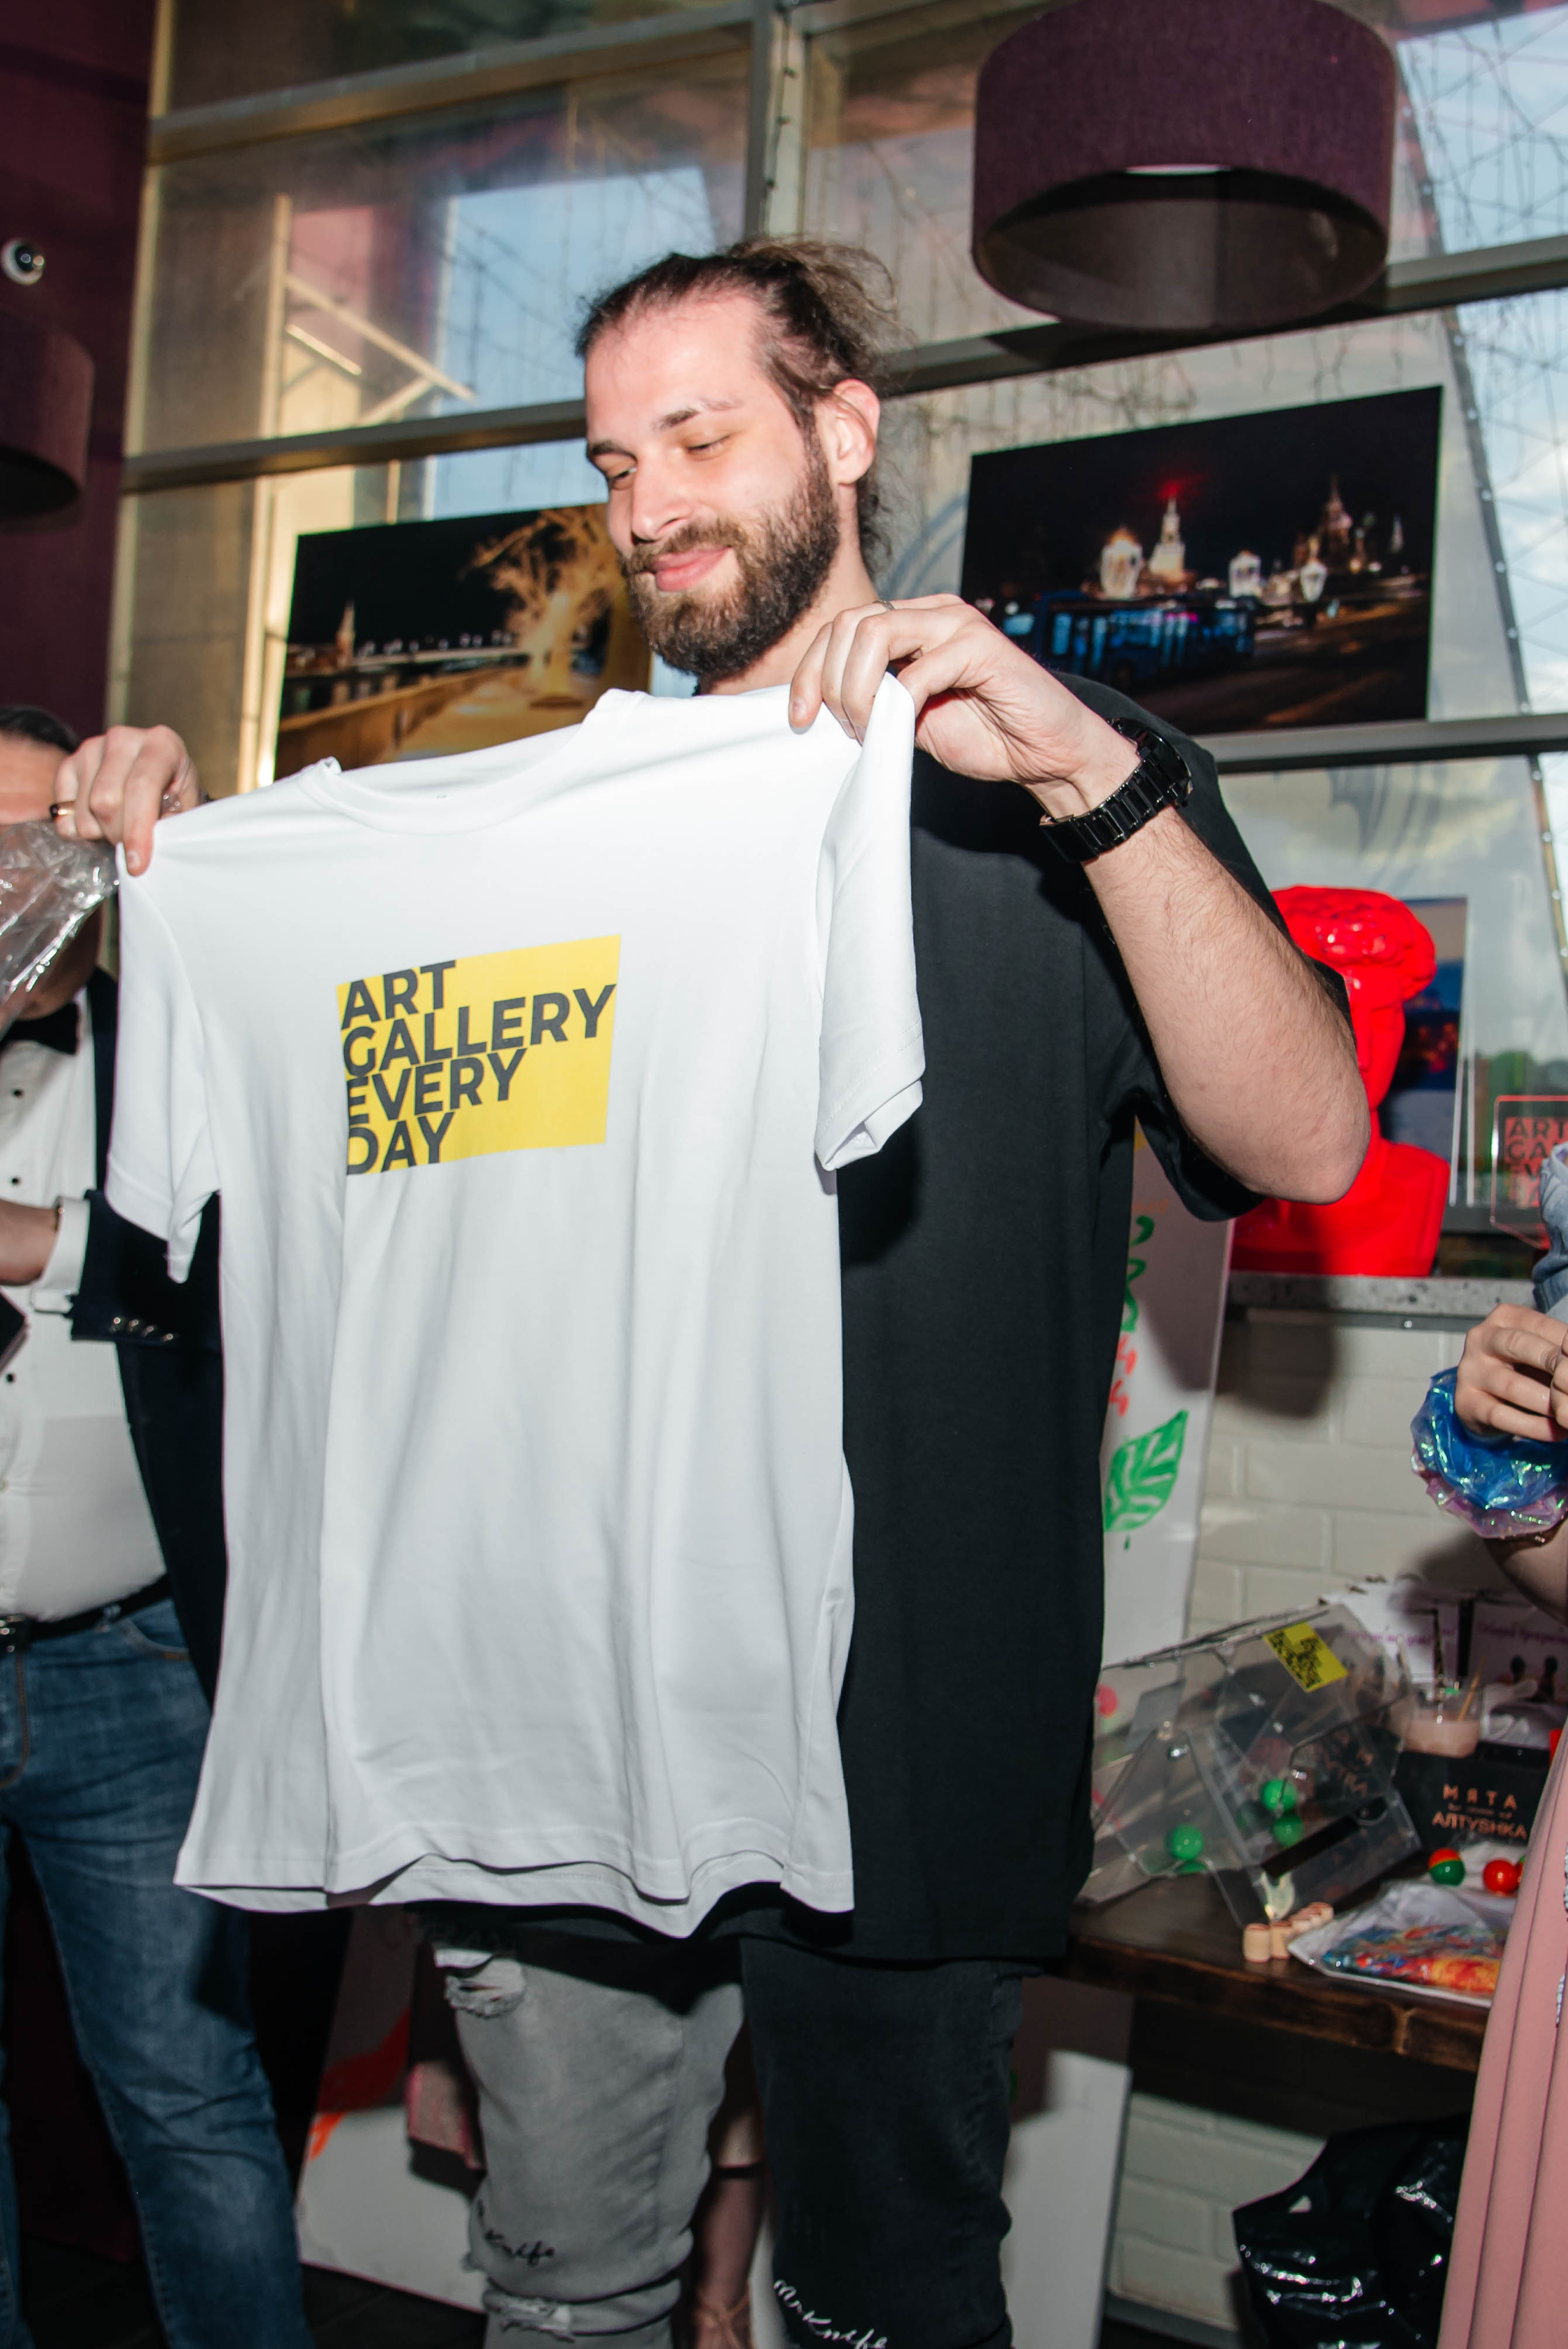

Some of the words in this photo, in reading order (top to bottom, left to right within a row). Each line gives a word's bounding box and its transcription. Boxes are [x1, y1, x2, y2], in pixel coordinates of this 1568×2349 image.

[341, 960, 456, 1030] ART
[343, 984, 617, 1077] GALLERY
[347, 1047, 527, 1125] EVERY
[346, 1112, 455, 1175] DAY
